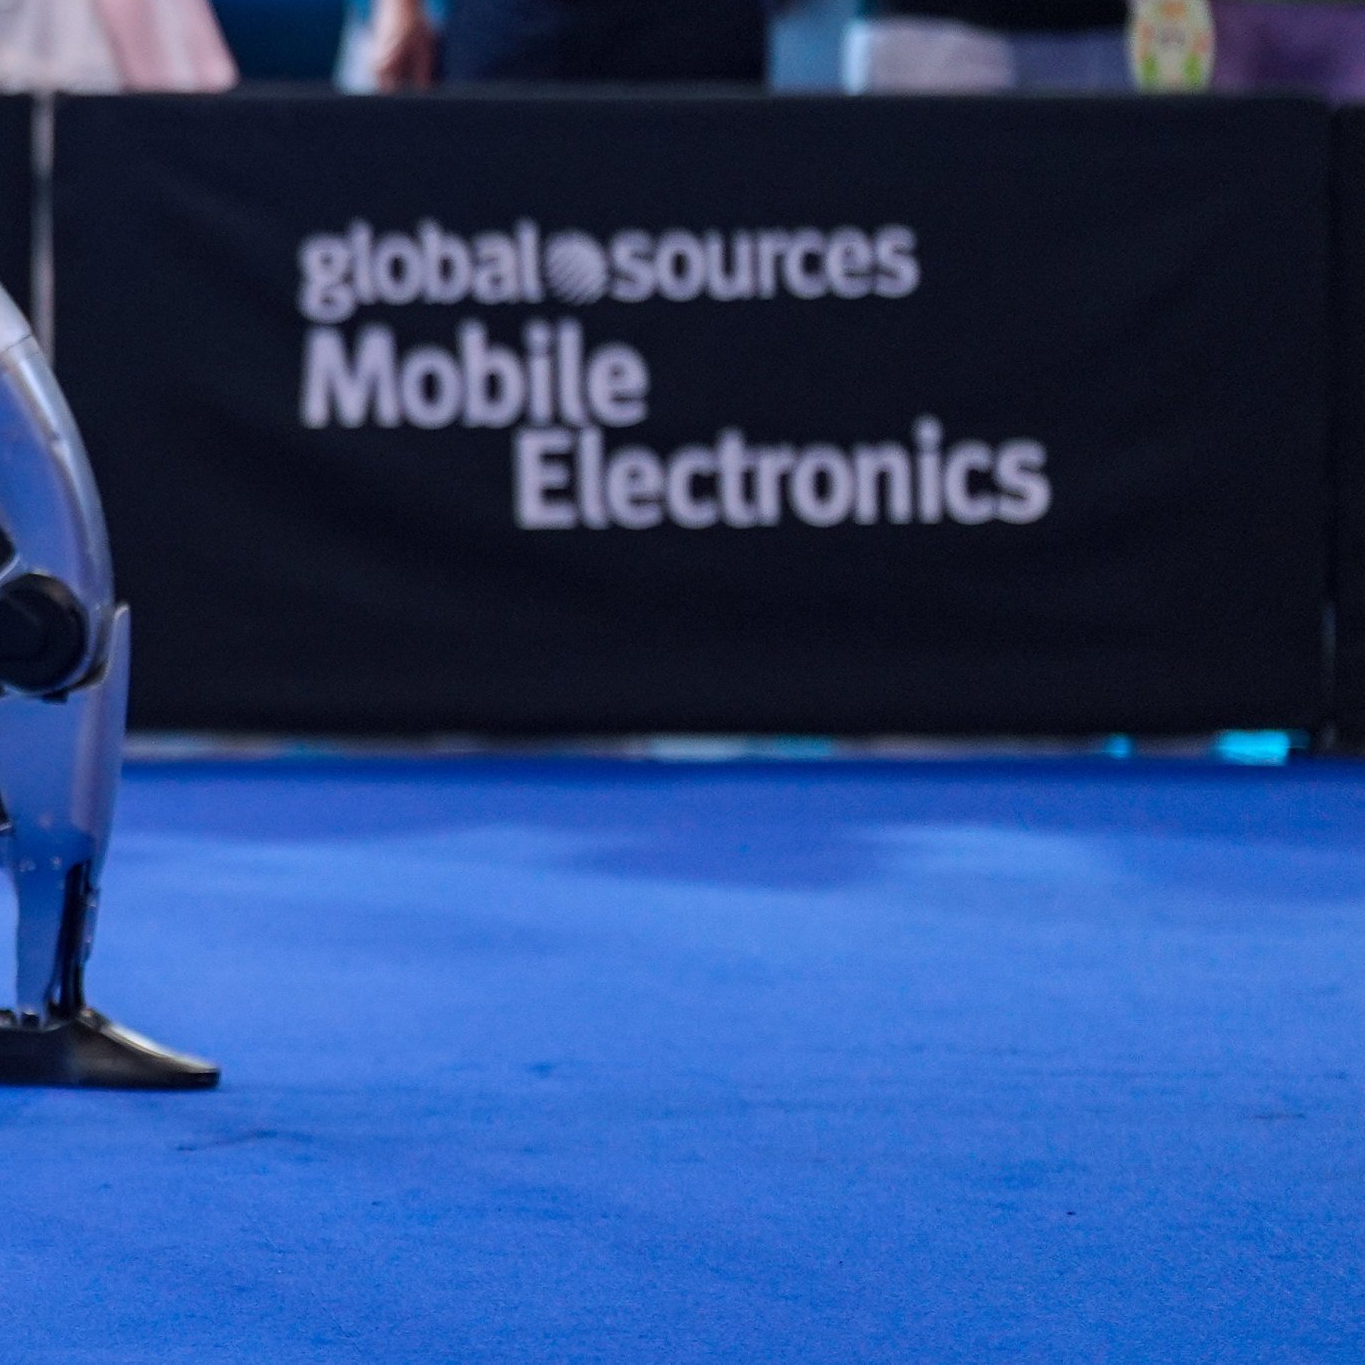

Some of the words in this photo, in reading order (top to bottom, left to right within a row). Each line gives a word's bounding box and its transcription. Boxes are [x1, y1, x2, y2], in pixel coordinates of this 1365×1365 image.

[297, 218, 544, 325] global
[604, 226, 922, 301] sources
[301, 317, 650, 429] Mobile
[513, 414, 1052, 531] Electronics
